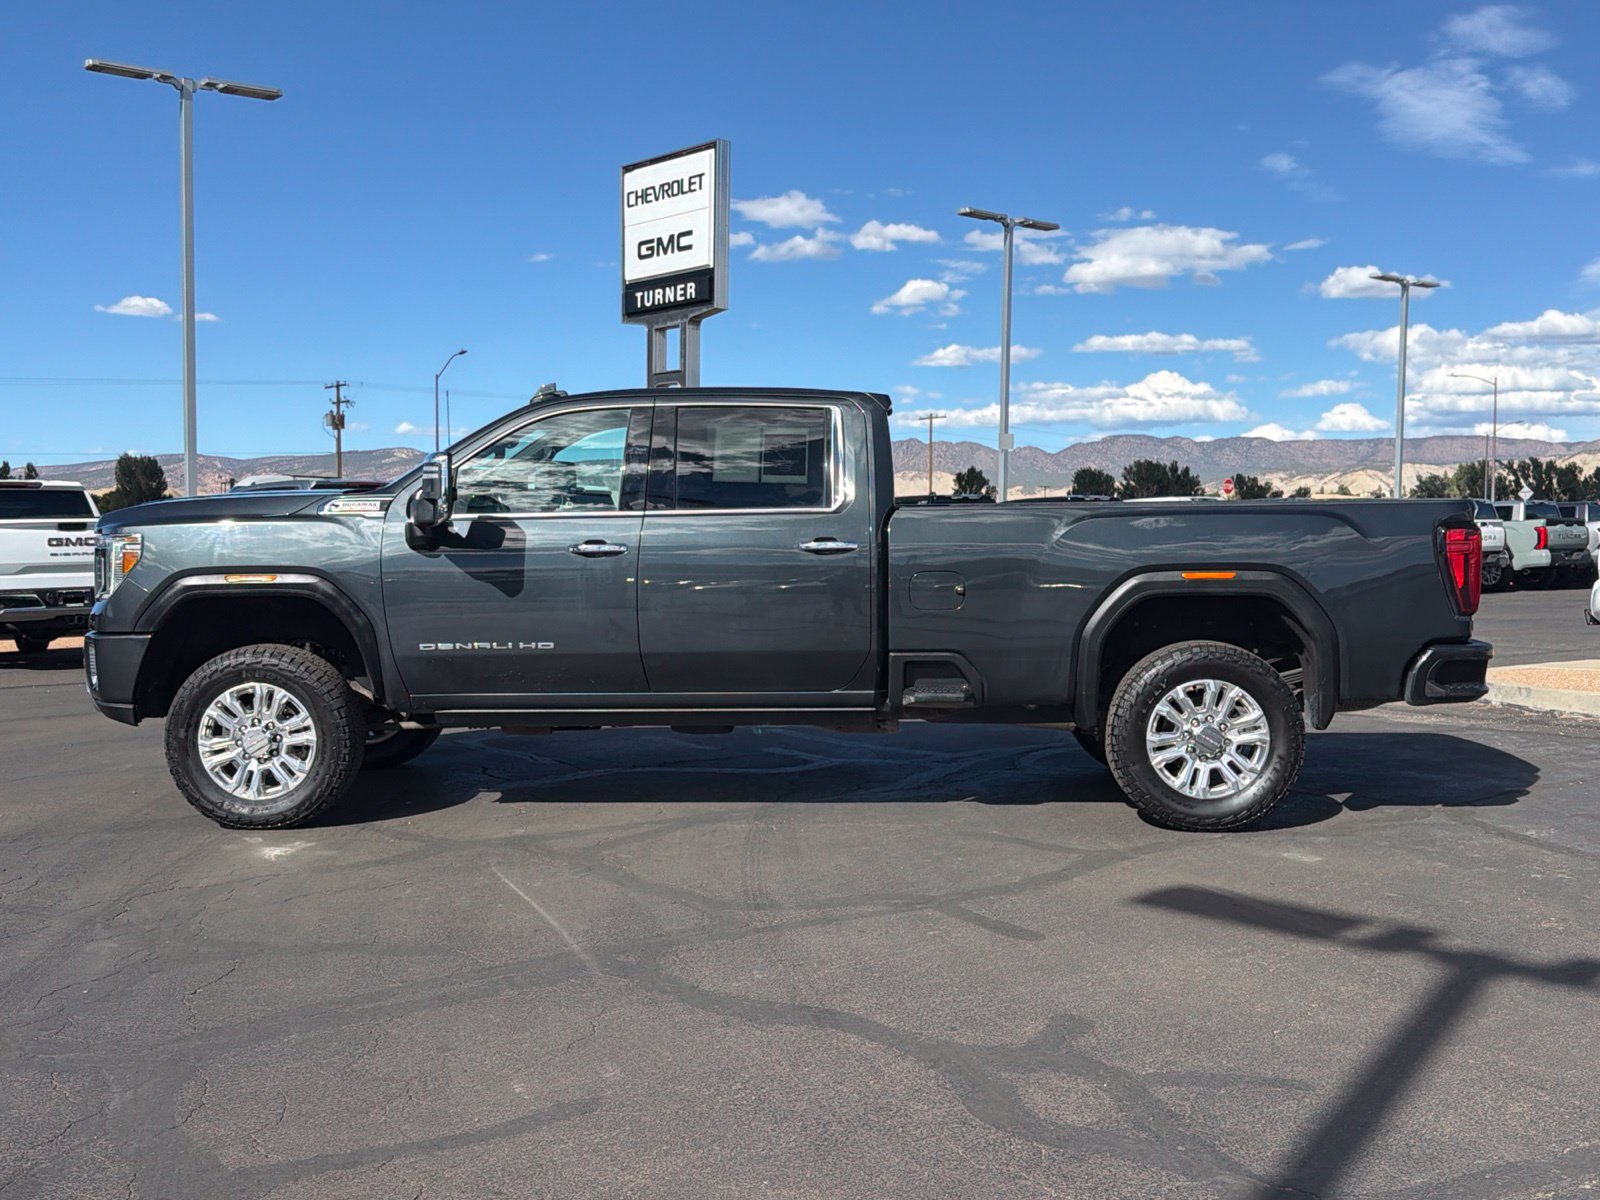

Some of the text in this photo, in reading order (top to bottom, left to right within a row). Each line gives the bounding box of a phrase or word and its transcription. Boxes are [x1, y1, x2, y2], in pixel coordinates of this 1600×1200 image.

[627, 173, 705, 208] CHEVROLET
[637, 230, 693, 260] GMC
[635, 282, 696, 308] TURNER
[48, 537, 96, 547] GMC
[419, 642, 513, 650] DENALI
